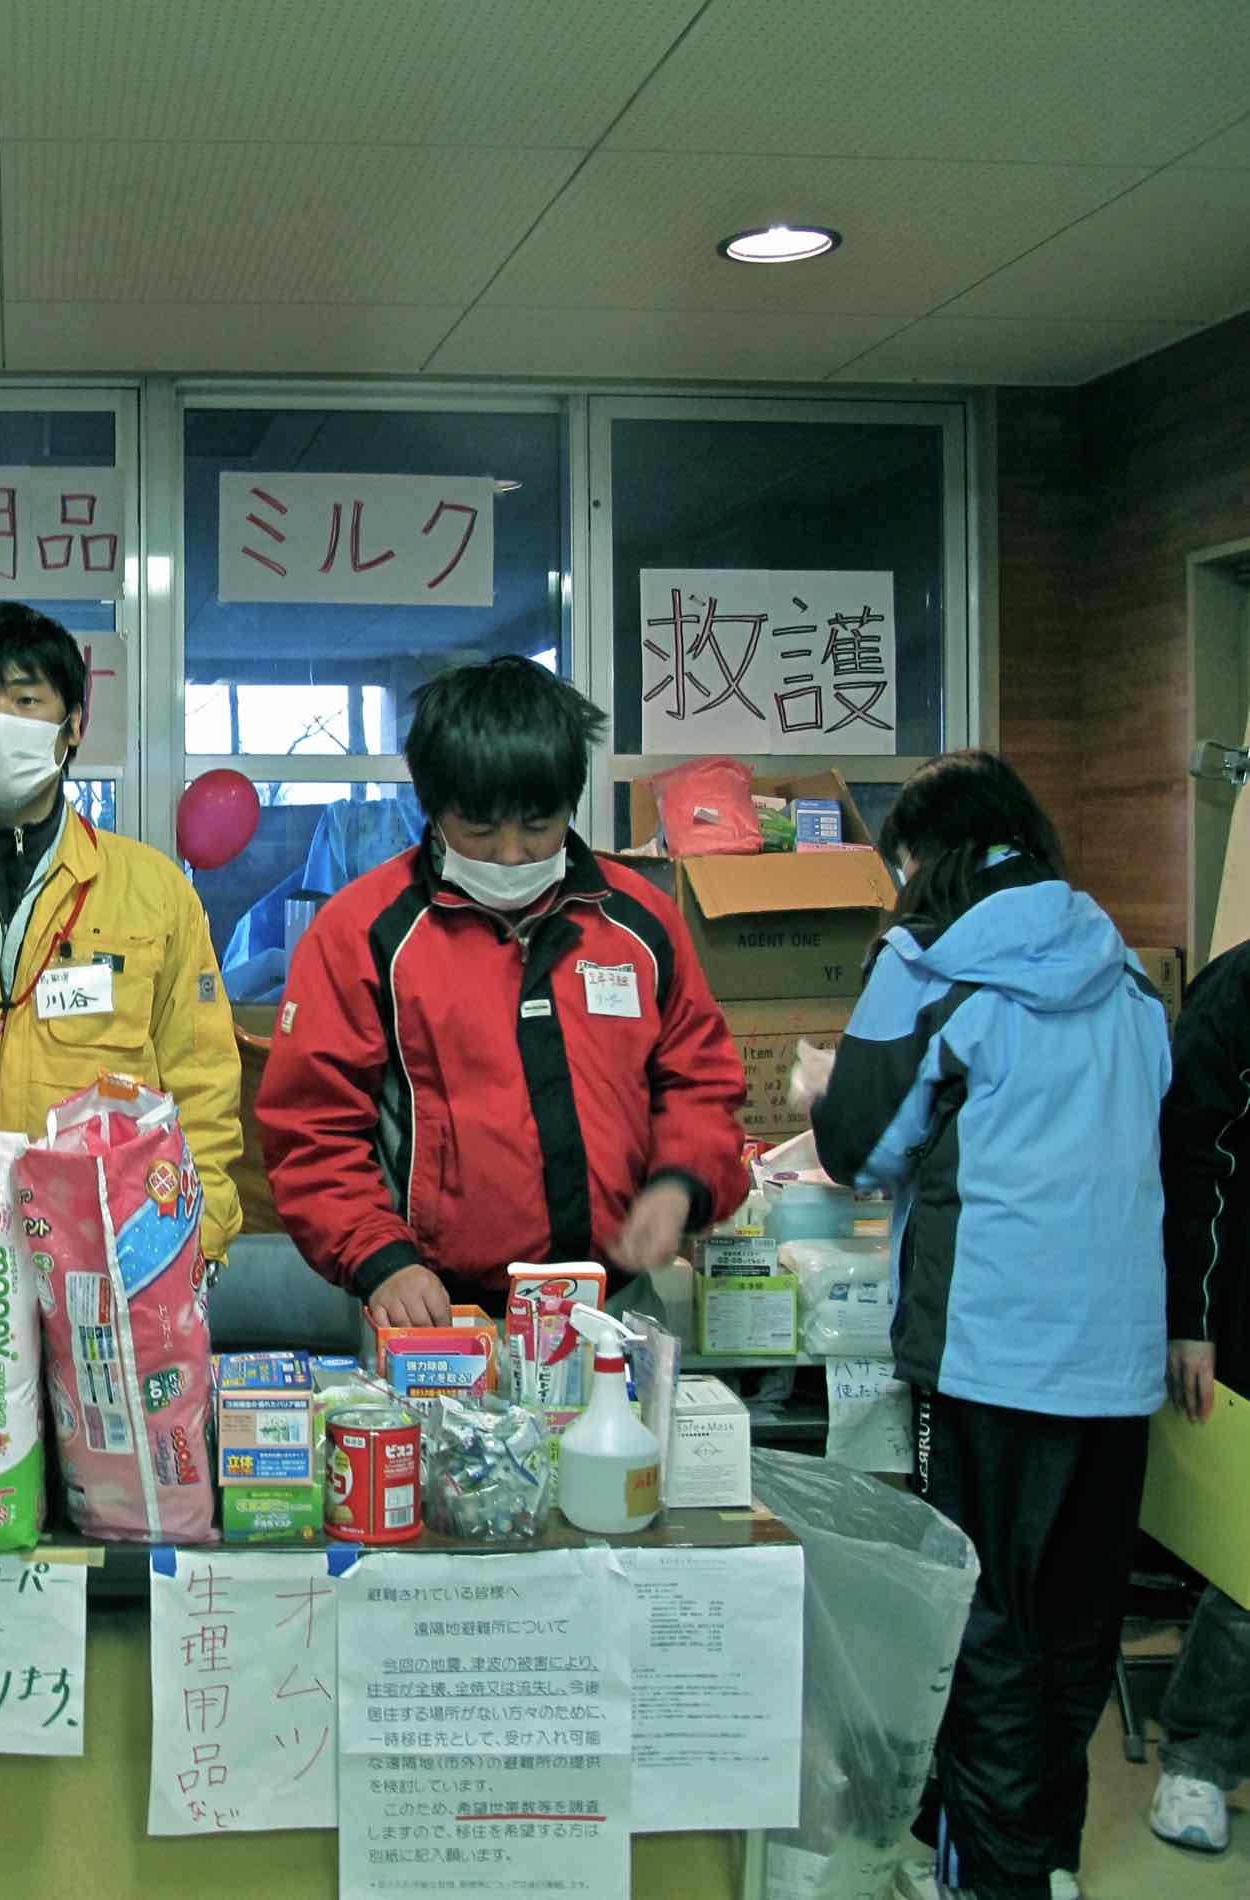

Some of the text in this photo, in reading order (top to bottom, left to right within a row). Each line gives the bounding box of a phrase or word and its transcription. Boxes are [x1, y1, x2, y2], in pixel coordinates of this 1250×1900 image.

[240, 487, 479, 588] ミルク
[643, 588, 895, 734] 救護
[736, 932, 822, 948] AGENT ONE
[177, 1564, 236, 1793] 生理用品
[275, 1576, 333, 1782] オムツ
